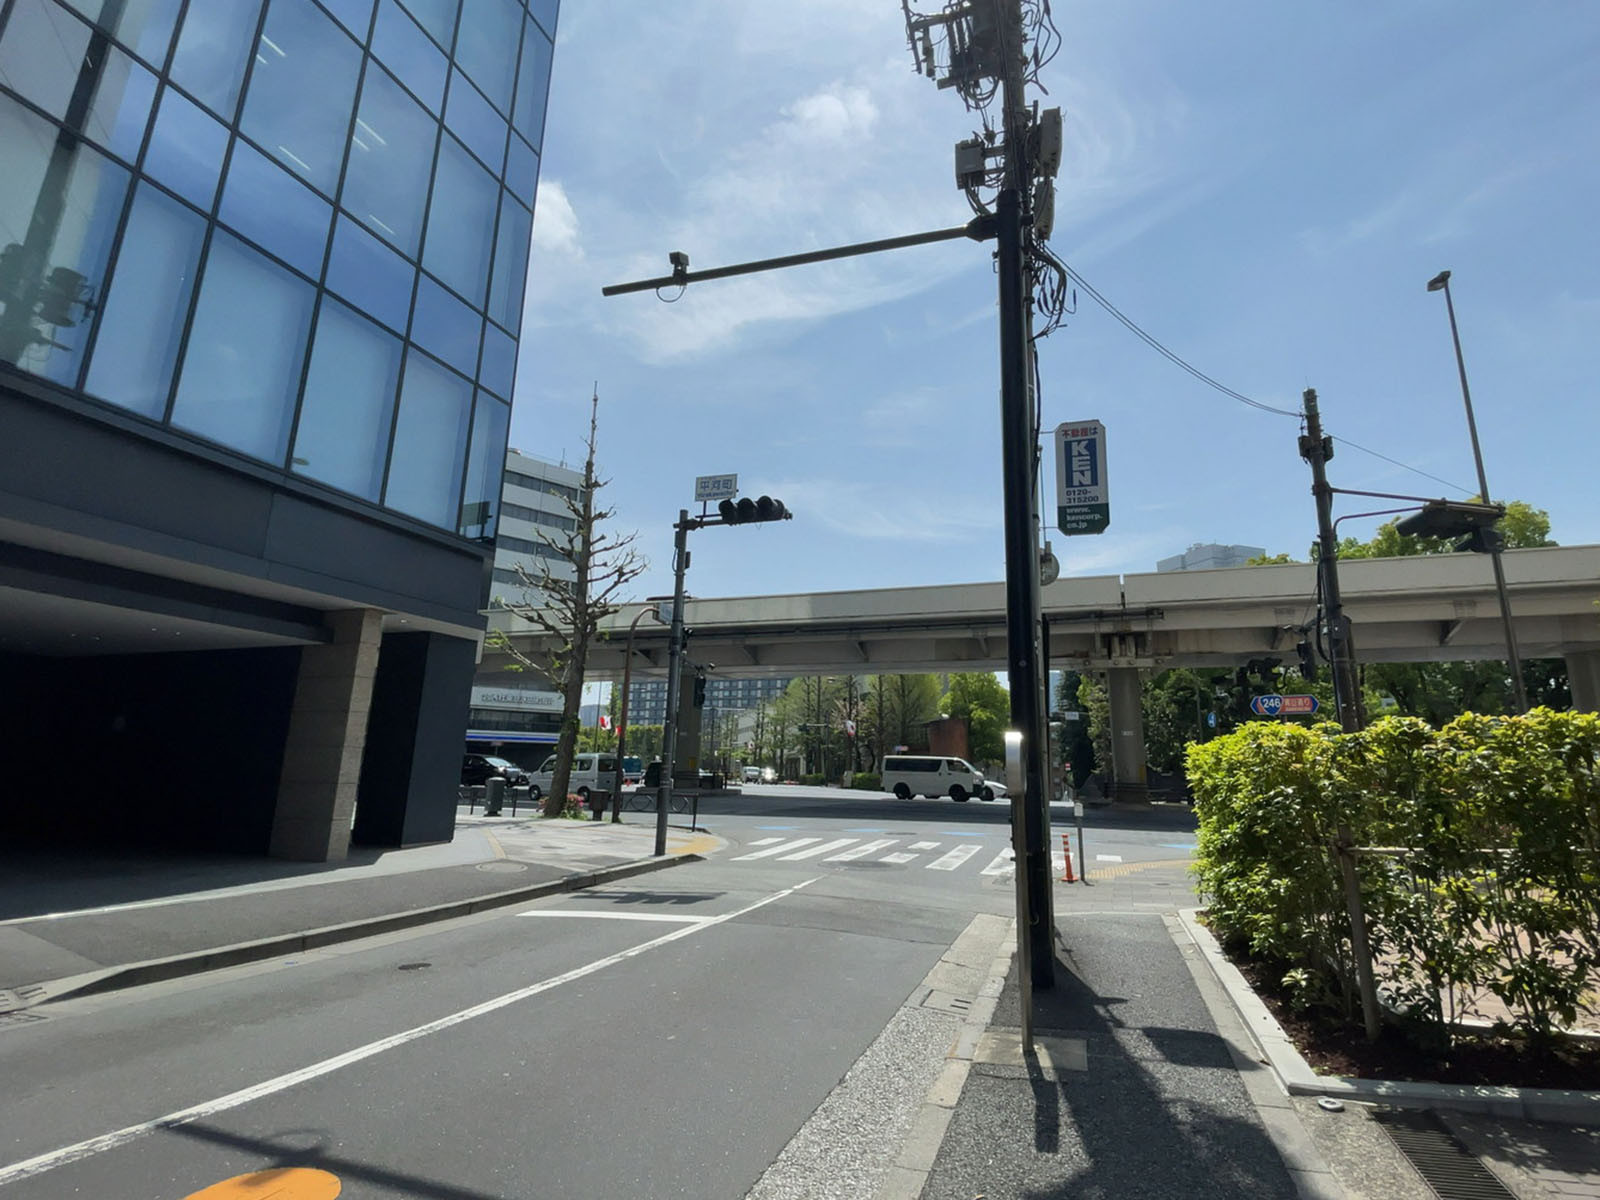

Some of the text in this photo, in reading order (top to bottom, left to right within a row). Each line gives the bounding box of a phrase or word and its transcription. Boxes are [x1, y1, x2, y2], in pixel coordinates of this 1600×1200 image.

[1071, 440, 1092, 486] KEN
[1066, 489, 1091, 497] 0120-
[1263, 698, 1281, 708] 246
